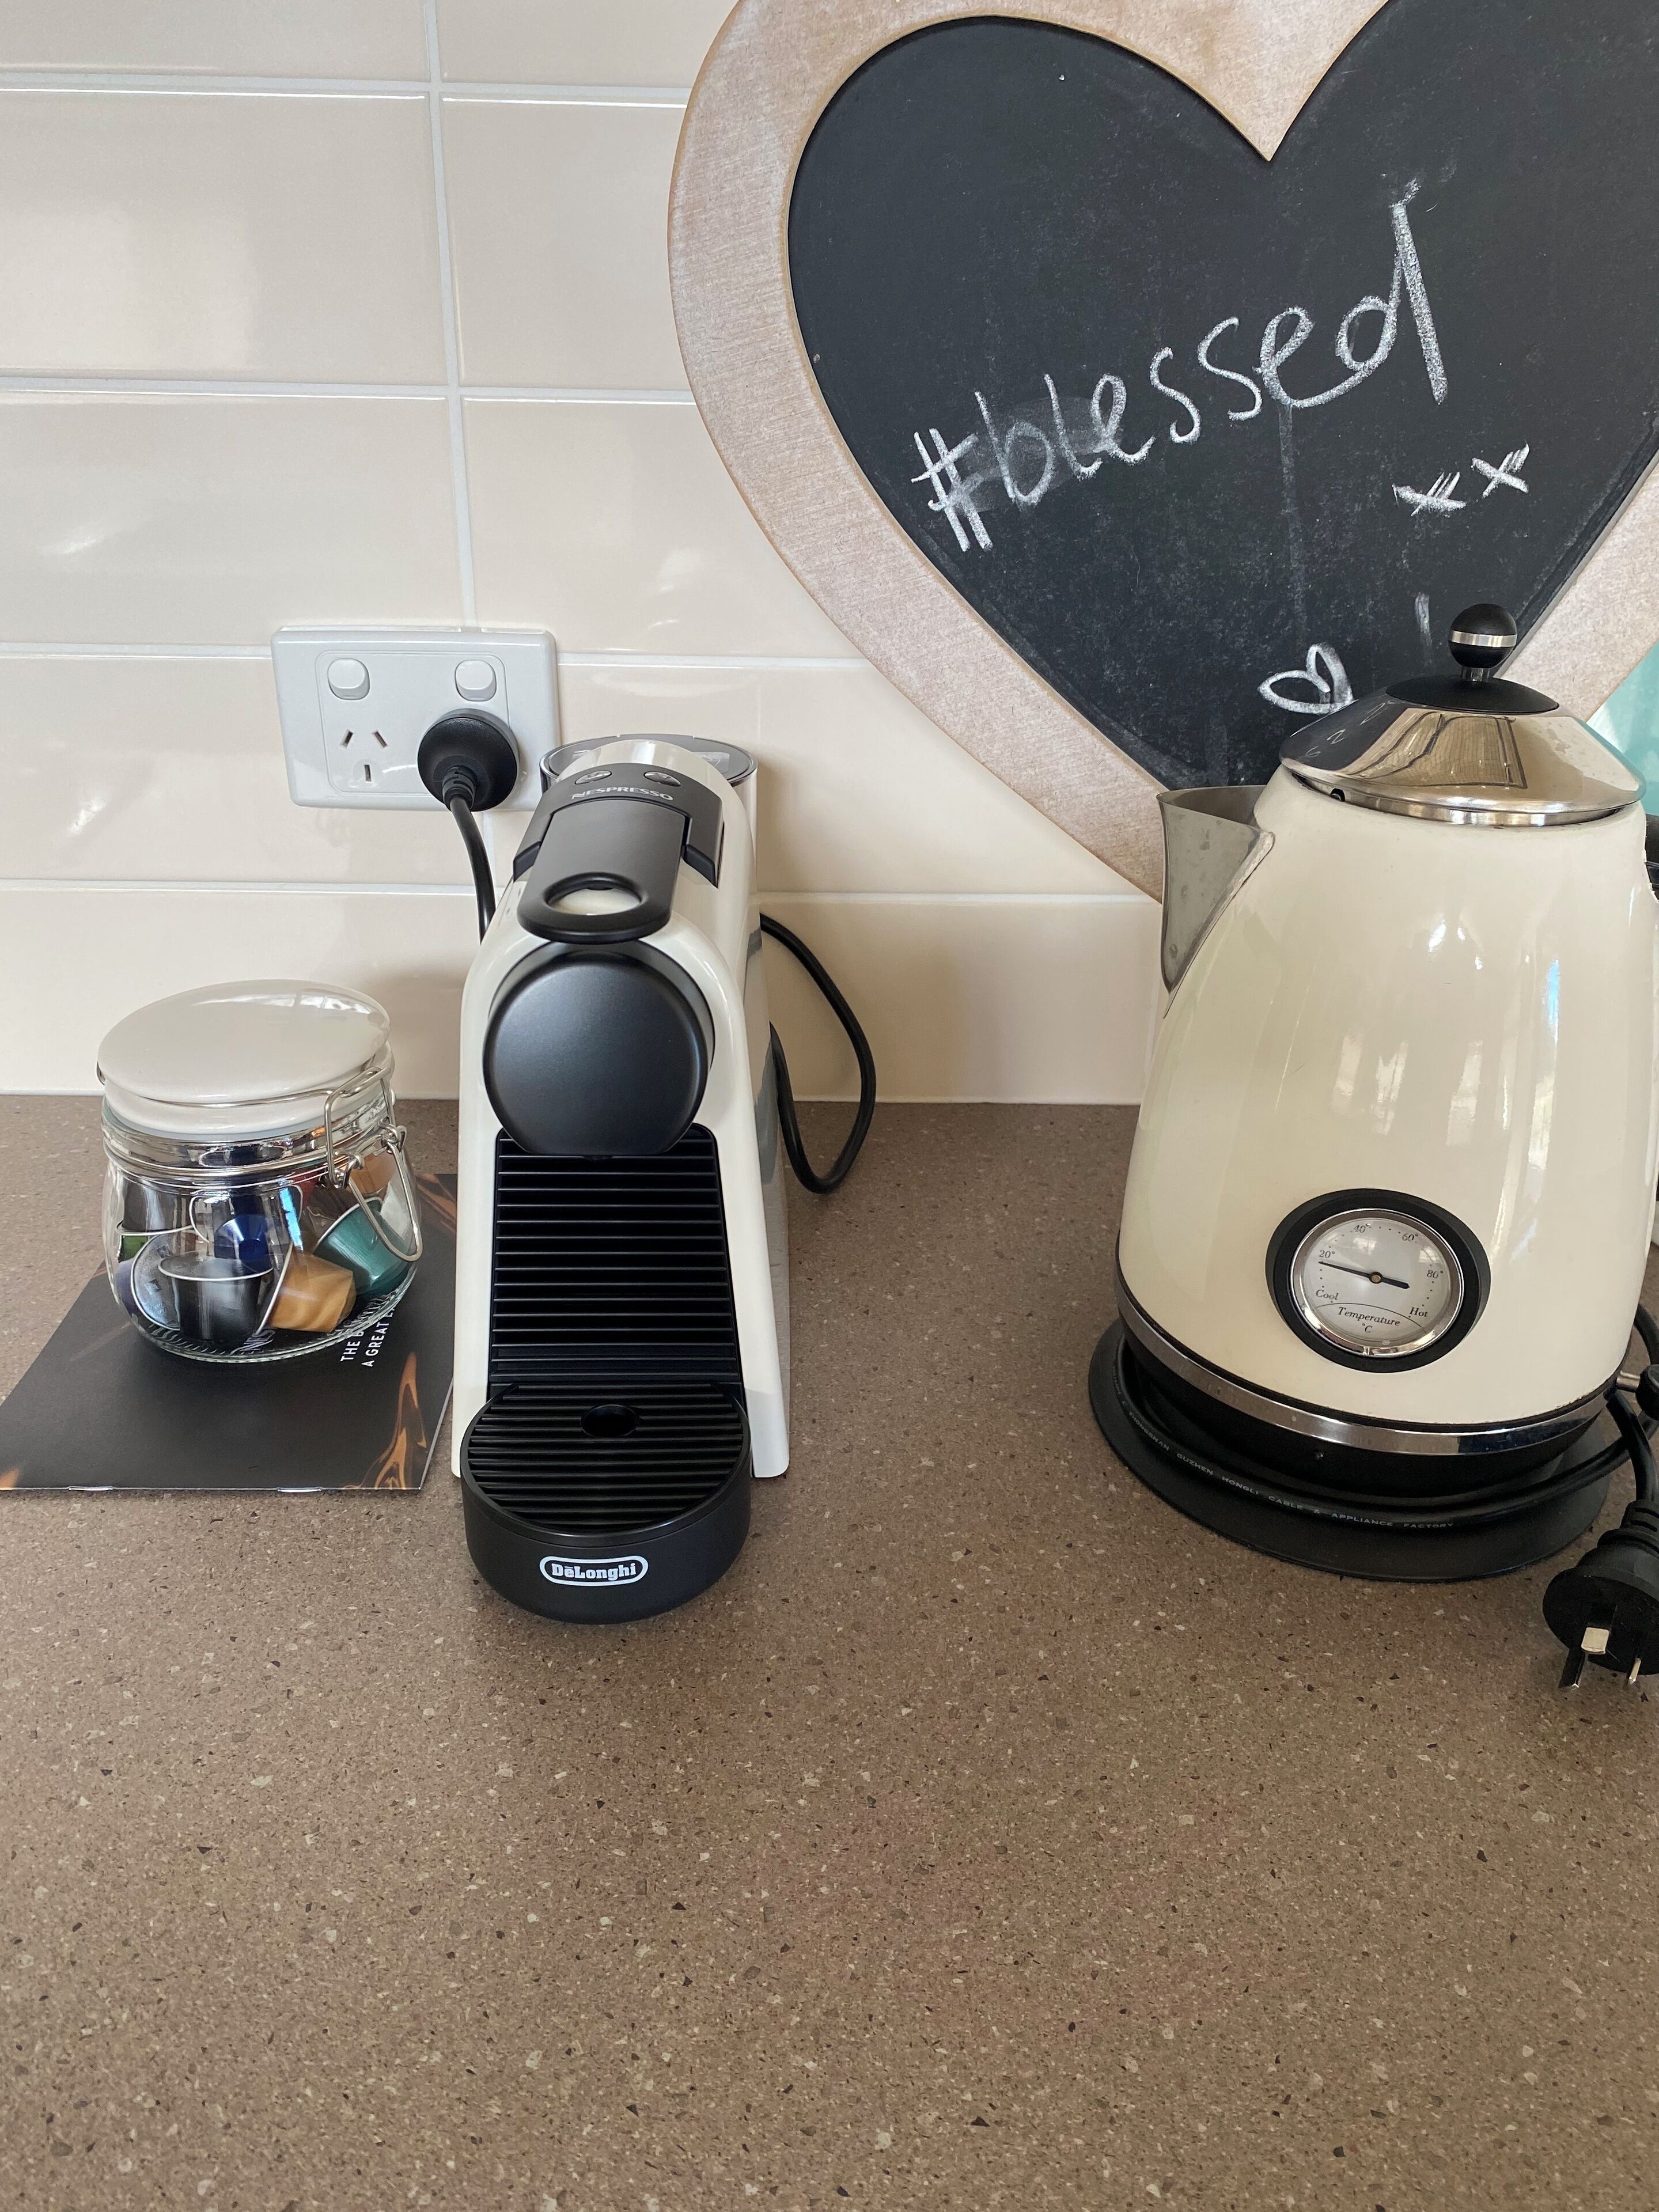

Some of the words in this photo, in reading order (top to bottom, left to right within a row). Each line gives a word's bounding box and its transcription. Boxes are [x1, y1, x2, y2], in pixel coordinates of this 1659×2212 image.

[911, 200, 1448, 552] #blessed
[571, 786, 673, 801] NESPRESSO
[1316, 1289, 1338, 1301] Cool
[1338, 1306, 1401, 1327] Temperature
[1409, 1307, 1428, 1318] Hot
[365, 1321, 389, 1357] GREAT
[340, 1341, 361, 1362] THE
[1222, 1476, 1259, 1495] HONGLI
[1331, 1513, 1393, 1527] APPLIANCE
